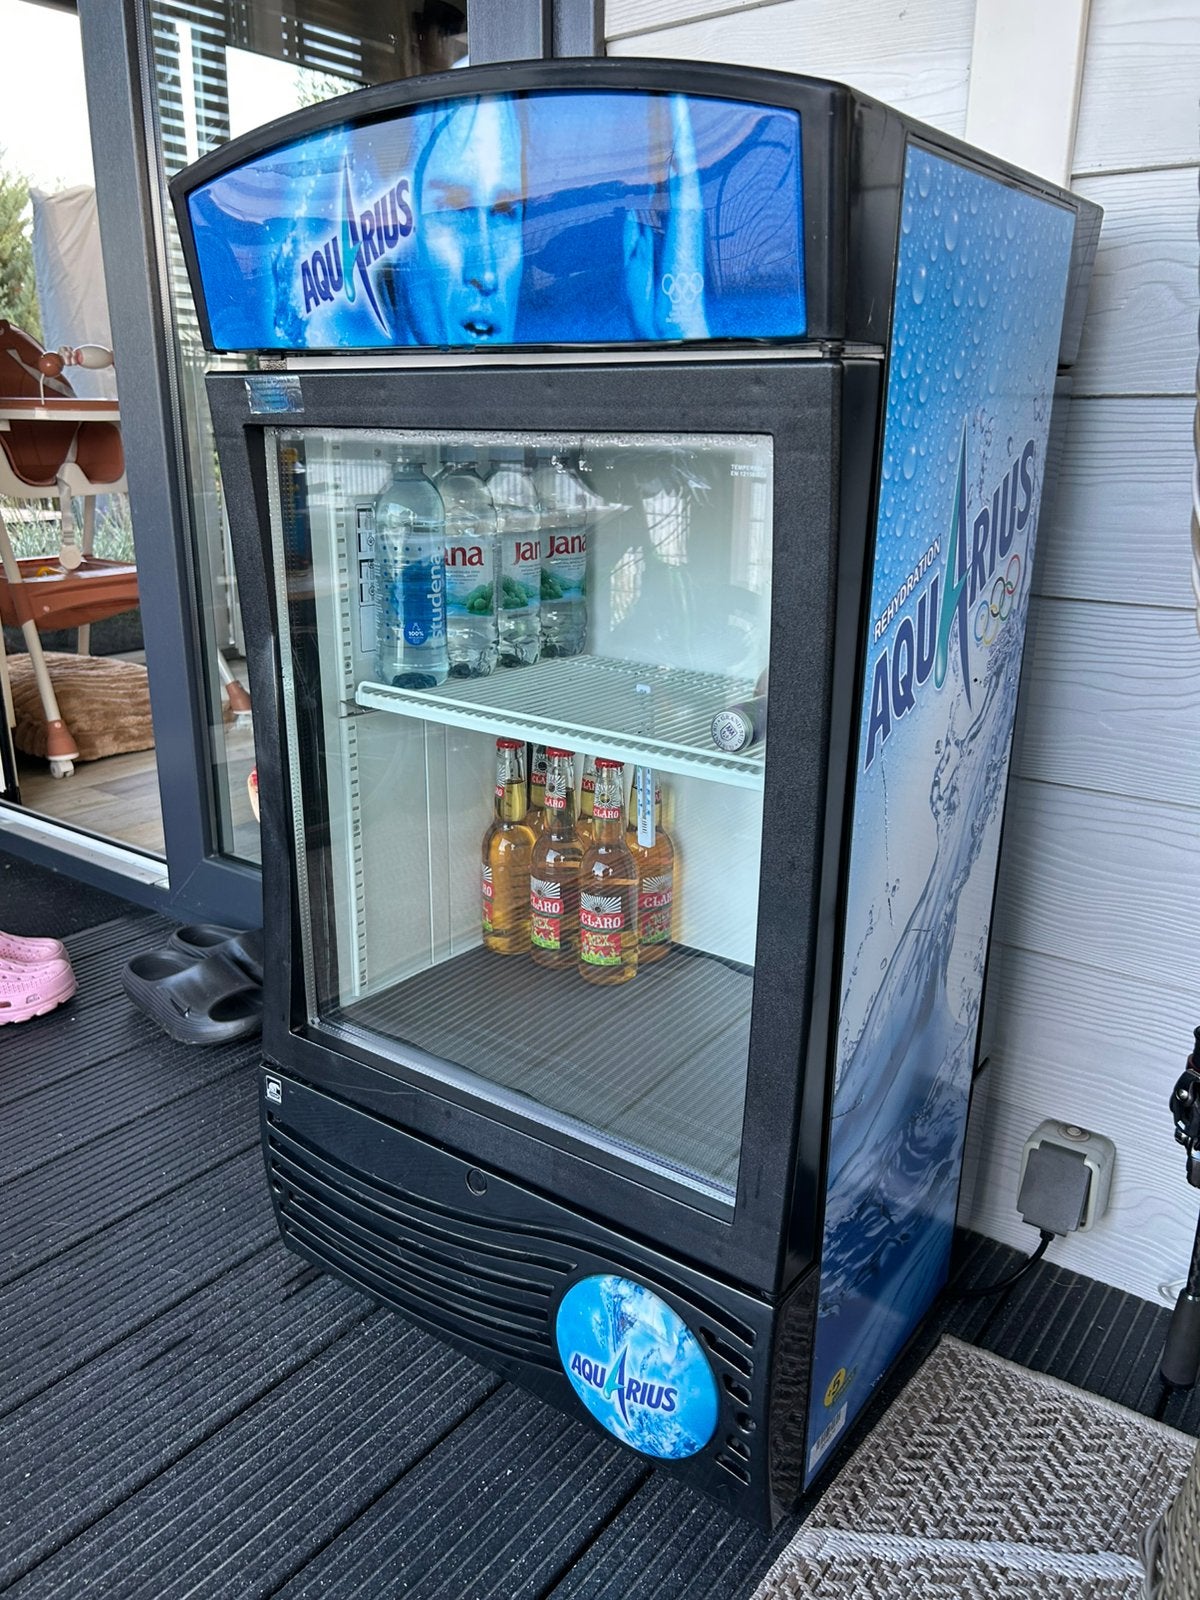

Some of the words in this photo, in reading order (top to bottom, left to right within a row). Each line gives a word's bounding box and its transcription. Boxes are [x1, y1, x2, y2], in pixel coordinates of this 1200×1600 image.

[300, 153, 414, 335] AQUARIUS
[427, 554, 443, 639] studena
[864, 416, 1035, 773] AQUARIUS
[874, 536, 942, 643] REHYDRATION
[580, 912, 621, 930] CLARO
[571, 1345, 678, 1426] AQUARIUS
